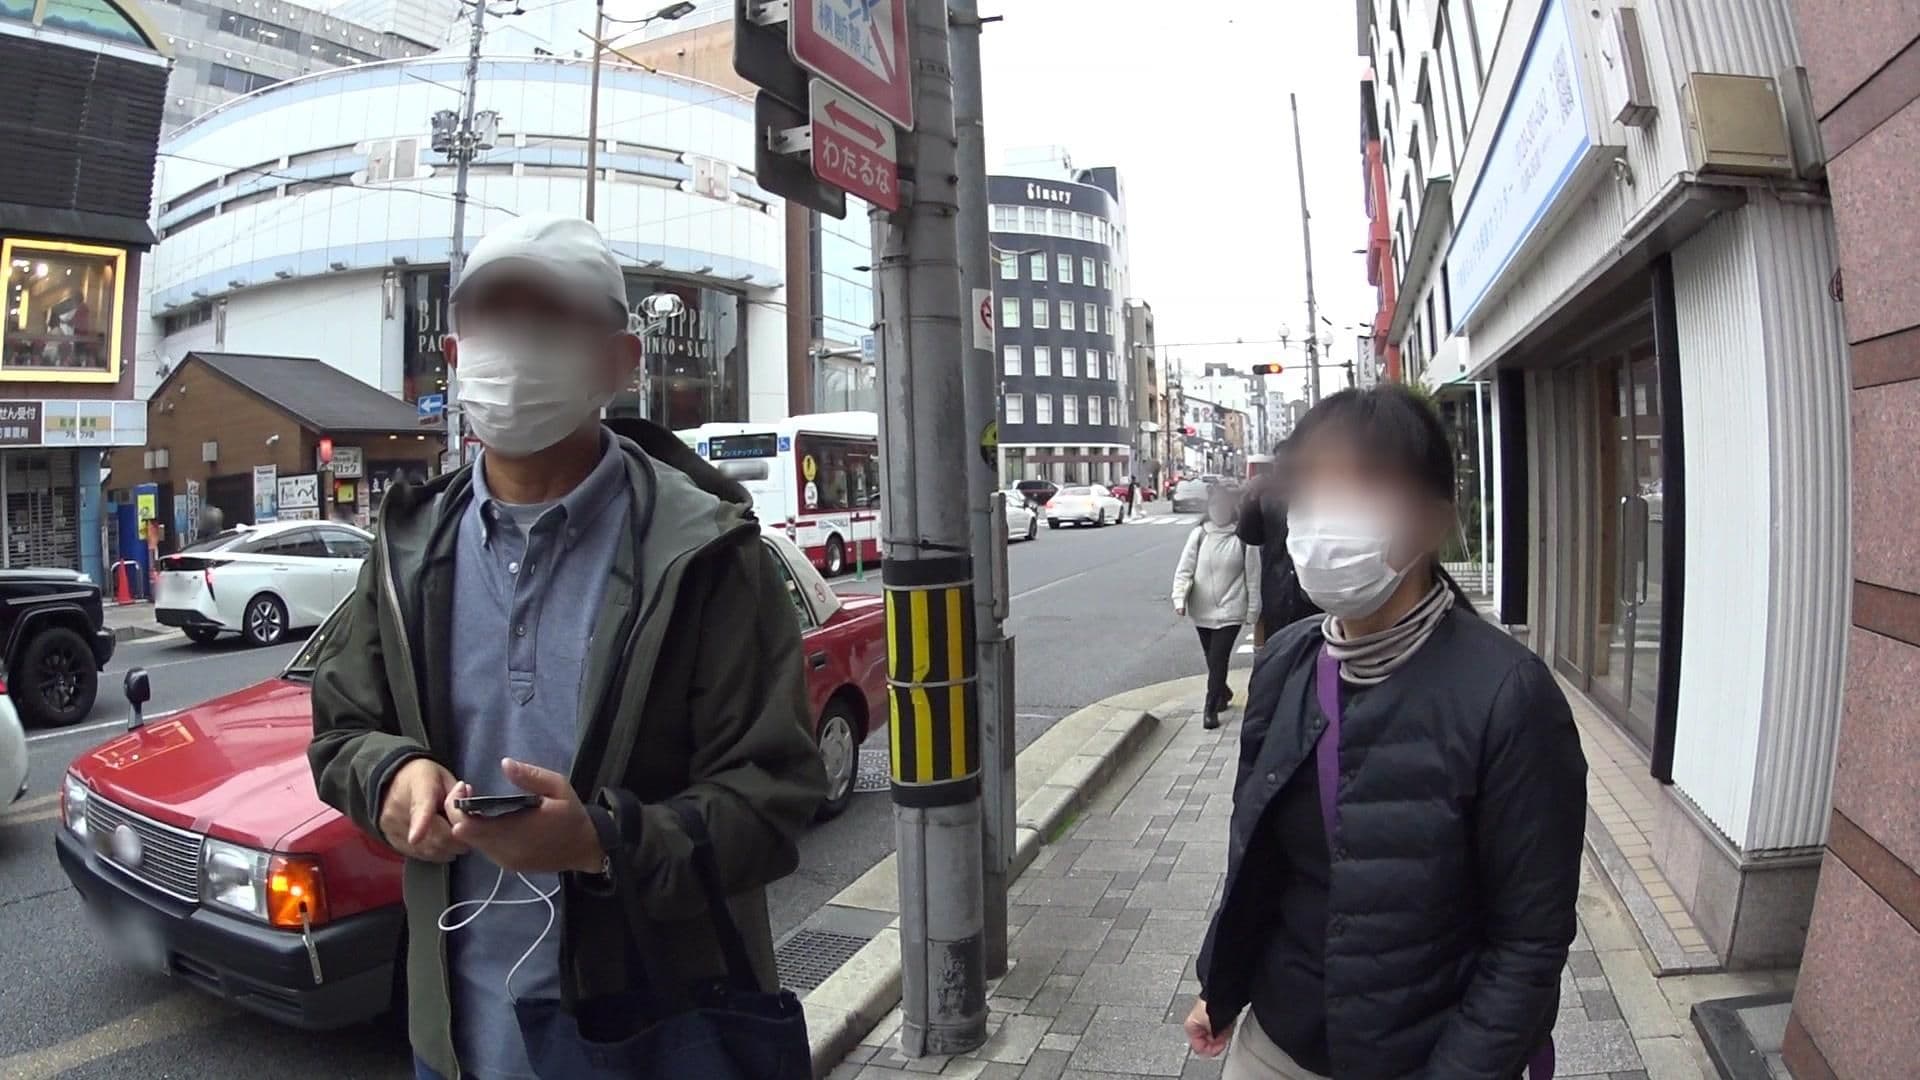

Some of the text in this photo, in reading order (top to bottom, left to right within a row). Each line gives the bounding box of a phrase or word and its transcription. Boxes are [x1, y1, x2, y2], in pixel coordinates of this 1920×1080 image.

[822, 136, 890, 195] わたるな
[418, 299, 442, 332] BI
[418, 335, 446, 353] PAC
